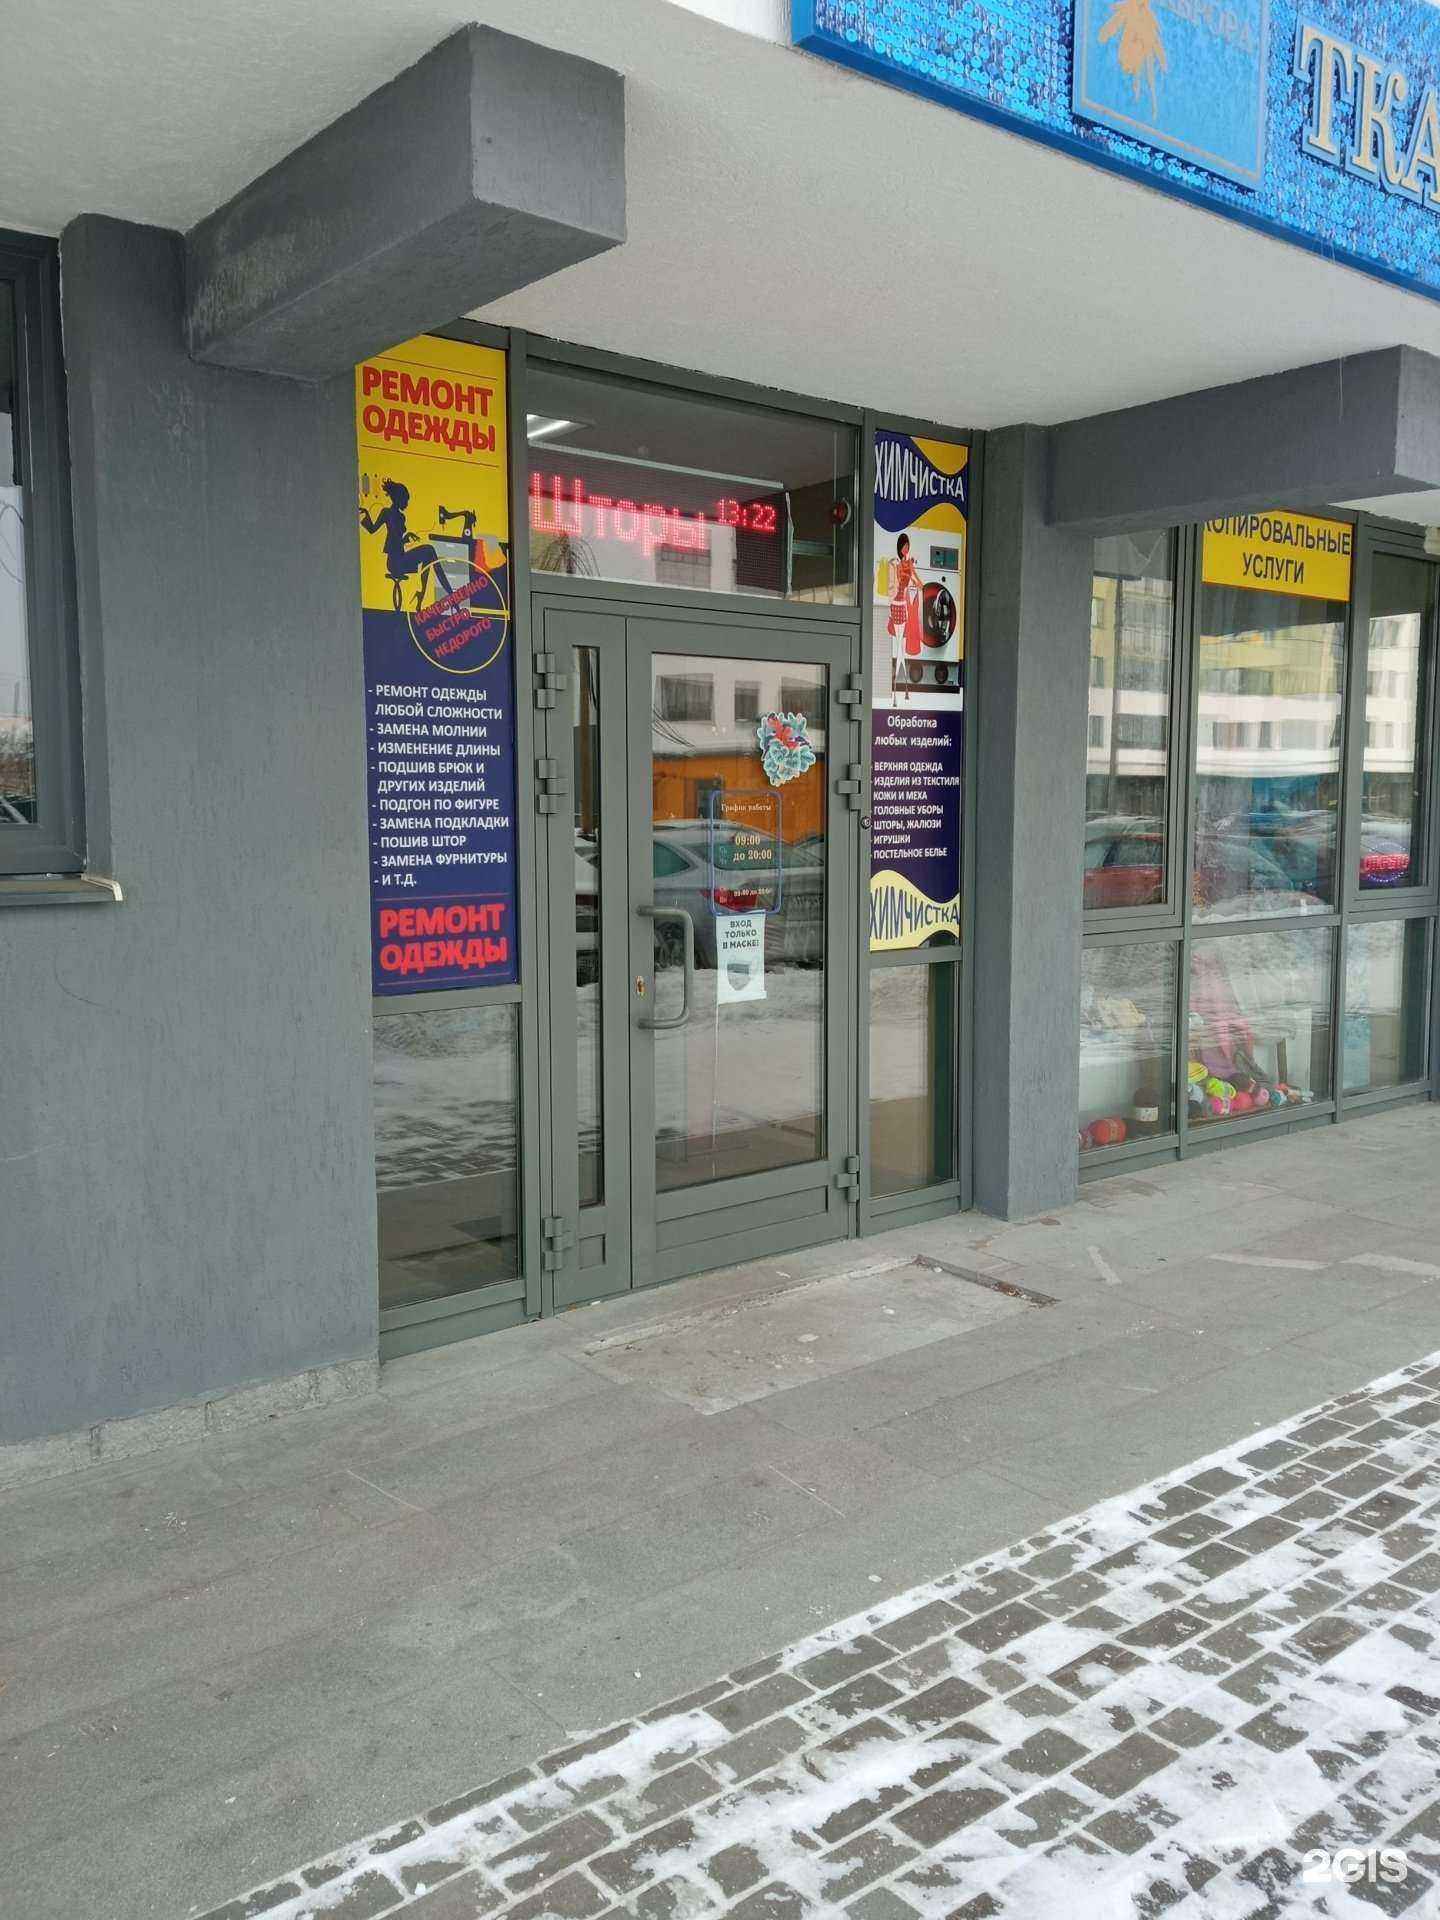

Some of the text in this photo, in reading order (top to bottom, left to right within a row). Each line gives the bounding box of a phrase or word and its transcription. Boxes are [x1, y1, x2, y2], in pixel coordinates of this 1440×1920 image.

[362, 366, 493, 417] РЕМОНТ
[363, 404, 495, 454] ОДЕЖДЫ
[874, 440, 964, 502] ХИМЧИСТКА
[532, 472, 777, 559] Шторы 13:22
[1242, 552, 1304, 584] УСЛУГИ
[434, 617, 492, 656] НЕДОРОГО
[376, 684, 487, 702] РЕМОНТ ОДЕЖДЫ
[375, 702, 503, 719] ЛЮБОЙ СЛОЖНОСТИ
[887, 715, 937, 730] Обработка
[377, 723, 487, 737] ЗАМЕНА МОЛНИИ
[874, 733, 952, 748] любых изделий:
[378, 742, 501, 757] ИЗМЕНЕНИЕ ДЛИНЫ
[378, 761, 484, 775] ПОДШИВ БРЮК И
[874, 761, 943, 774] ВЕРХНЯЯ ОДЕЖДА
[378, 778, 485, 794] ДРУГИХ ИЗДЕЛИЙ
[874, 776, 960, 788] ИЗДЕЛИЯ ИЗ ТЕКСТИЛЯ
[873, 791, 927, 801] КОЖИ И МЕХА
[379, 798, 499, 812] ПОДГОН ПО ФИГУРЕ
[721, 800, 771, 813] График работы
[874, 805, 944, 815] ГОЛОВНЫЕ УБОРЫ
[380, 816, 509, 830] ЗАМЕНА ПОДКЛАДКИ
[874, 819, 941, 831] ШТОРЫ, ЖАЛЮЗИ
[381, 835, 466, 848] ПОШИВ ШТОР
[735, 833, 760, 846] 09:00
[873, 834, 910, 845] ИГРУШКИ
[381, 852, 507, 867] ЗАМЕНА ФУРНИТУРЫ
[733, 851, 746, 863] до
[747, 849, 772, 861] 20:00
[874, 848, 947, 860] ПОСТЕЛЬНОЕ БЕЛЬЕ
[382, 873, 417, 887] И Т.Д.
[870, 885, 960, 940] ХИМЧИСТКА
[379, 903, 505, 938] РЕМОНТ
[730, 920, 752, 928] ВХОД
[725, 929, 757, 938] ТОЛЬКО
[380, 937, 508, 975] ОДЕЖДЫ
